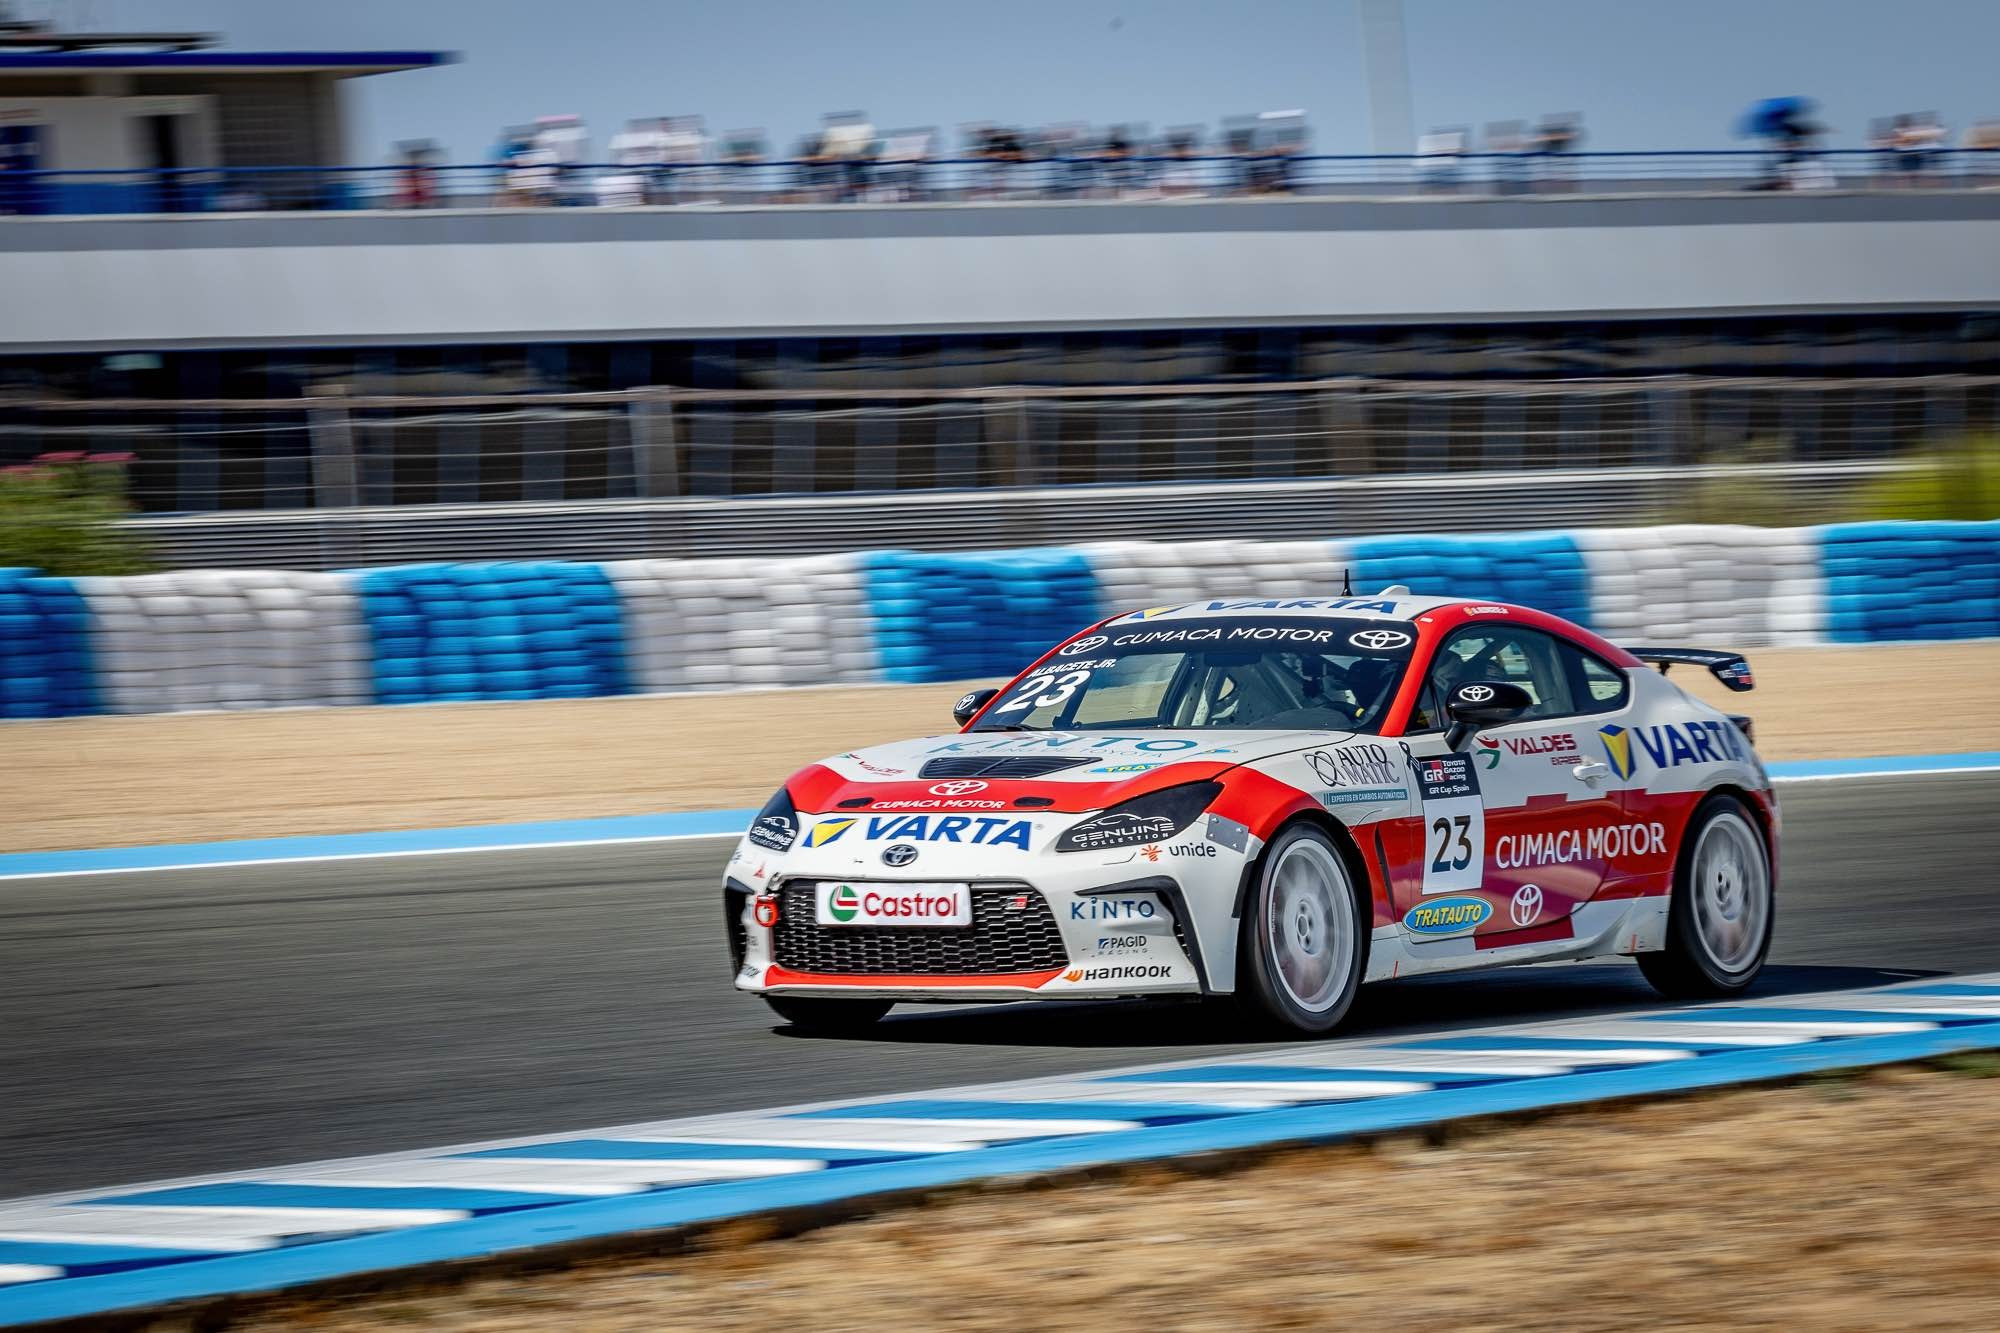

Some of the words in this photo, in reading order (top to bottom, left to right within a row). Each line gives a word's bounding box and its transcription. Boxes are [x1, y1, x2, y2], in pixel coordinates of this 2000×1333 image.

[1206, 599, 1398, 614] VARTA
[1113, 628, 1222, 646] CUMACA
[1227, 627, 1333, 642] MOTOR
[1026, 660, 1093, 678] ALBACETE
[1093, 658, 1117, 668] JR.
[995, 670, 1091, 714] 23
[1504, 733, 1577, 755] VALDES
[1632, 721, 1745, 769] VARTA
[1334, 743, 1388, 766] AUTO
[1340, 760, 1400, 785] MATIC
[1424, 769, 1444, 782] GR
[1443, 766, 1466, 774] GAZOO
[1331, 794, 1352, 803] EXPERTOS
[1359, 792, 1378, 801] CAMBIOS
[1429, 787, 1440, 795] GR
[1440, 786, 1452, 795] Cup
[1452, 784, 1470, 794] Spain
[870, 800, 942, 810] CUMACA
[943, 799, 1006, 809] MOTOR
[865, 815, 1033, 852] VARTA
[1072, 822, 1175, 843] GENUINE
[1080, 832, 1169, 848] COLLECTION
[1169, 842, 1217, 858] unide
[1432, 815, 1473, 874] 23
[1496, 829, 1583, 869] CUMACA
[1586, 822, 1668, 860] MOTOR
[864, 892, 958, 917] Castrol
[1414, 904, 1482, 929] TRATAUTO
[1110, 936, 1147, 948] PAGID
